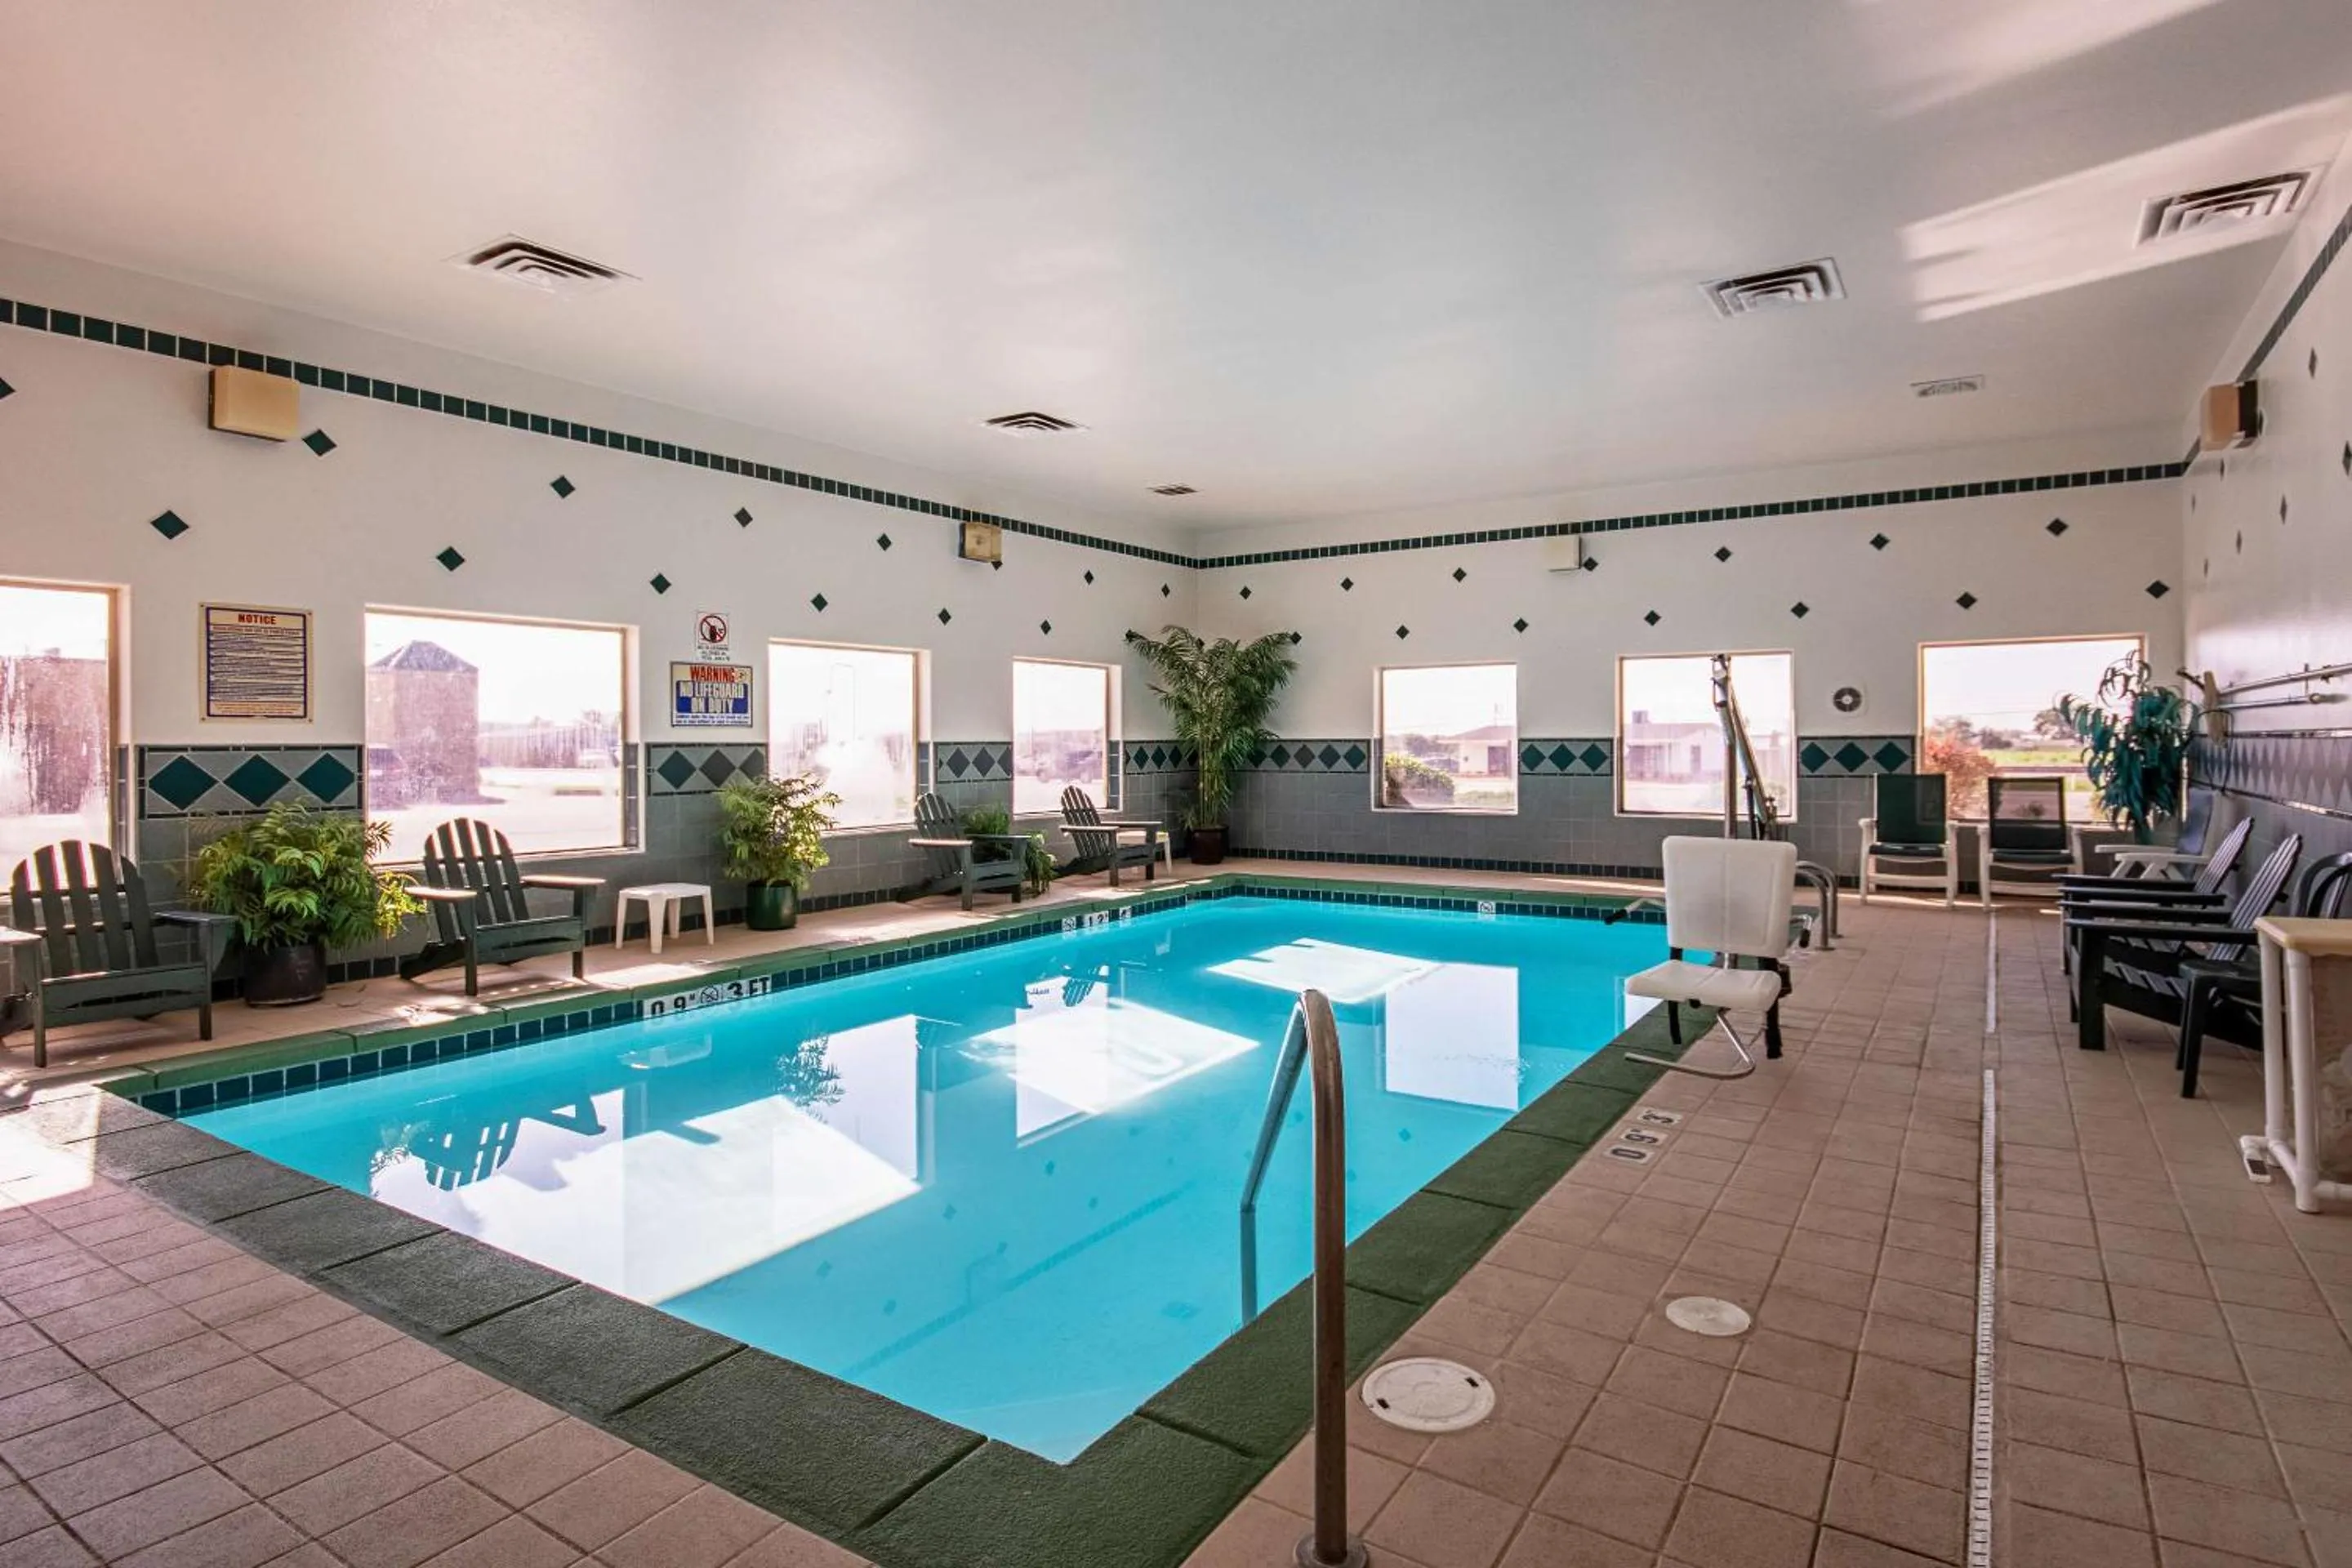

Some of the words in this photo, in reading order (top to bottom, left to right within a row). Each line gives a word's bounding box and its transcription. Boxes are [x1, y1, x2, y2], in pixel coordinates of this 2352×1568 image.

[238, 613, 277, 625] NOTICE
[690, 666, 735, 683] WARNING
[695, 682, 744, 698] LIFEGUARD
[749, 976, 770, 996] FT
